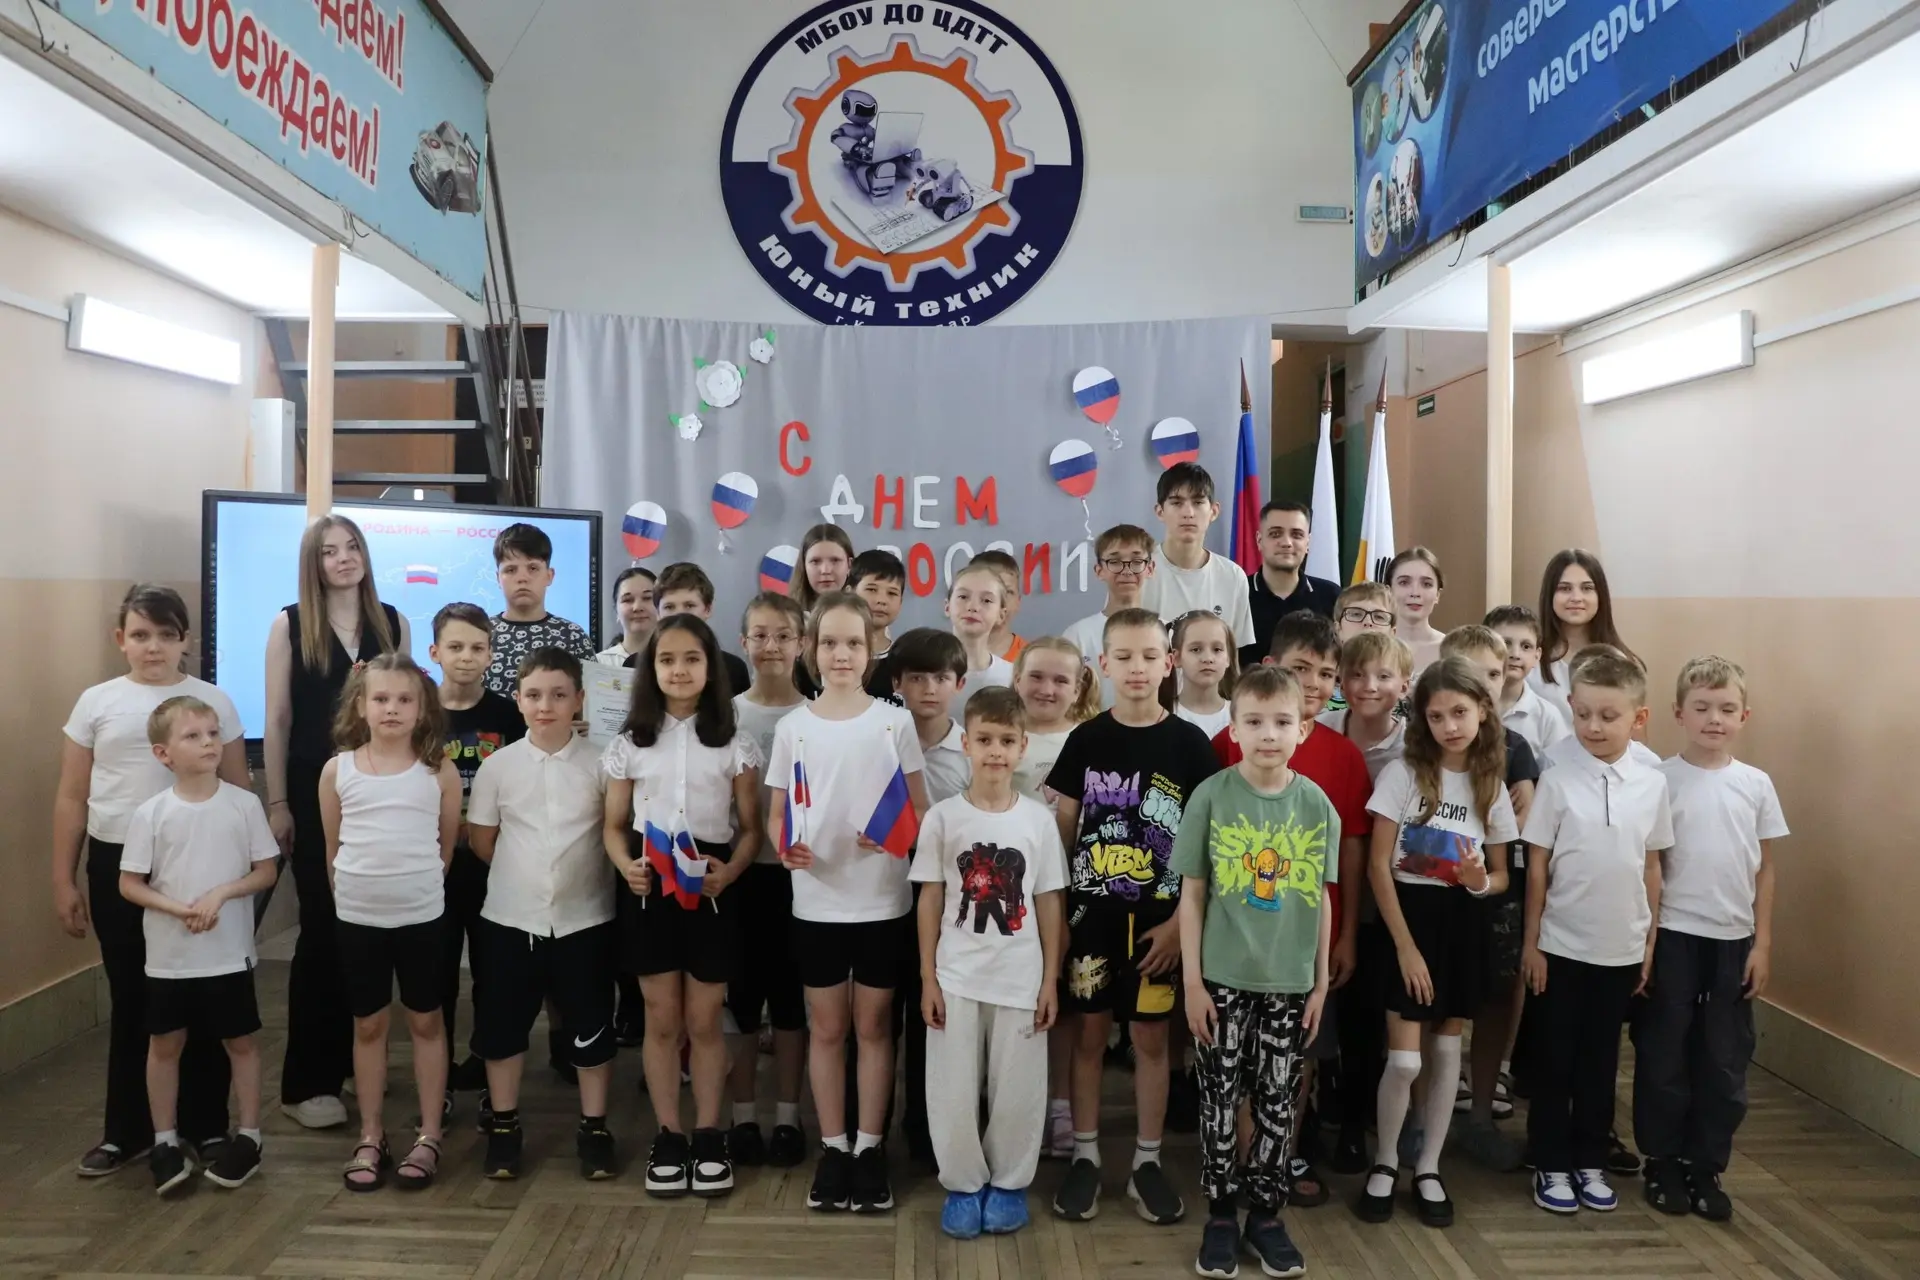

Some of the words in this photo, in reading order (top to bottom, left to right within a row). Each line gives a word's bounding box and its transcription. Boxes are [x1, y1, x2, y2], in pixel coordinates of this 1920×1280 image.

[315, 0, 405, 89] даем!
[795, 6, 873, 55] МБОУ
[883, 4, 924, 25] ДО
[932, 8, 1009, 55] ЦДТТ
[1528, 0, 1681, 114] мастерст
[759, 234, 876, 317] Юный
[894, 242, 1040, 319] техник
[779, 420, 812, 477] С
[363, 522, 431, 537] РОДИНА
[820, 473, 999, 531] ДНЕМ
[877, 540, 1089, 598] ОСИИ
[1418, 796, 1467, 823] РССИЯ
[1214, 820, 1320, 859] STAY
